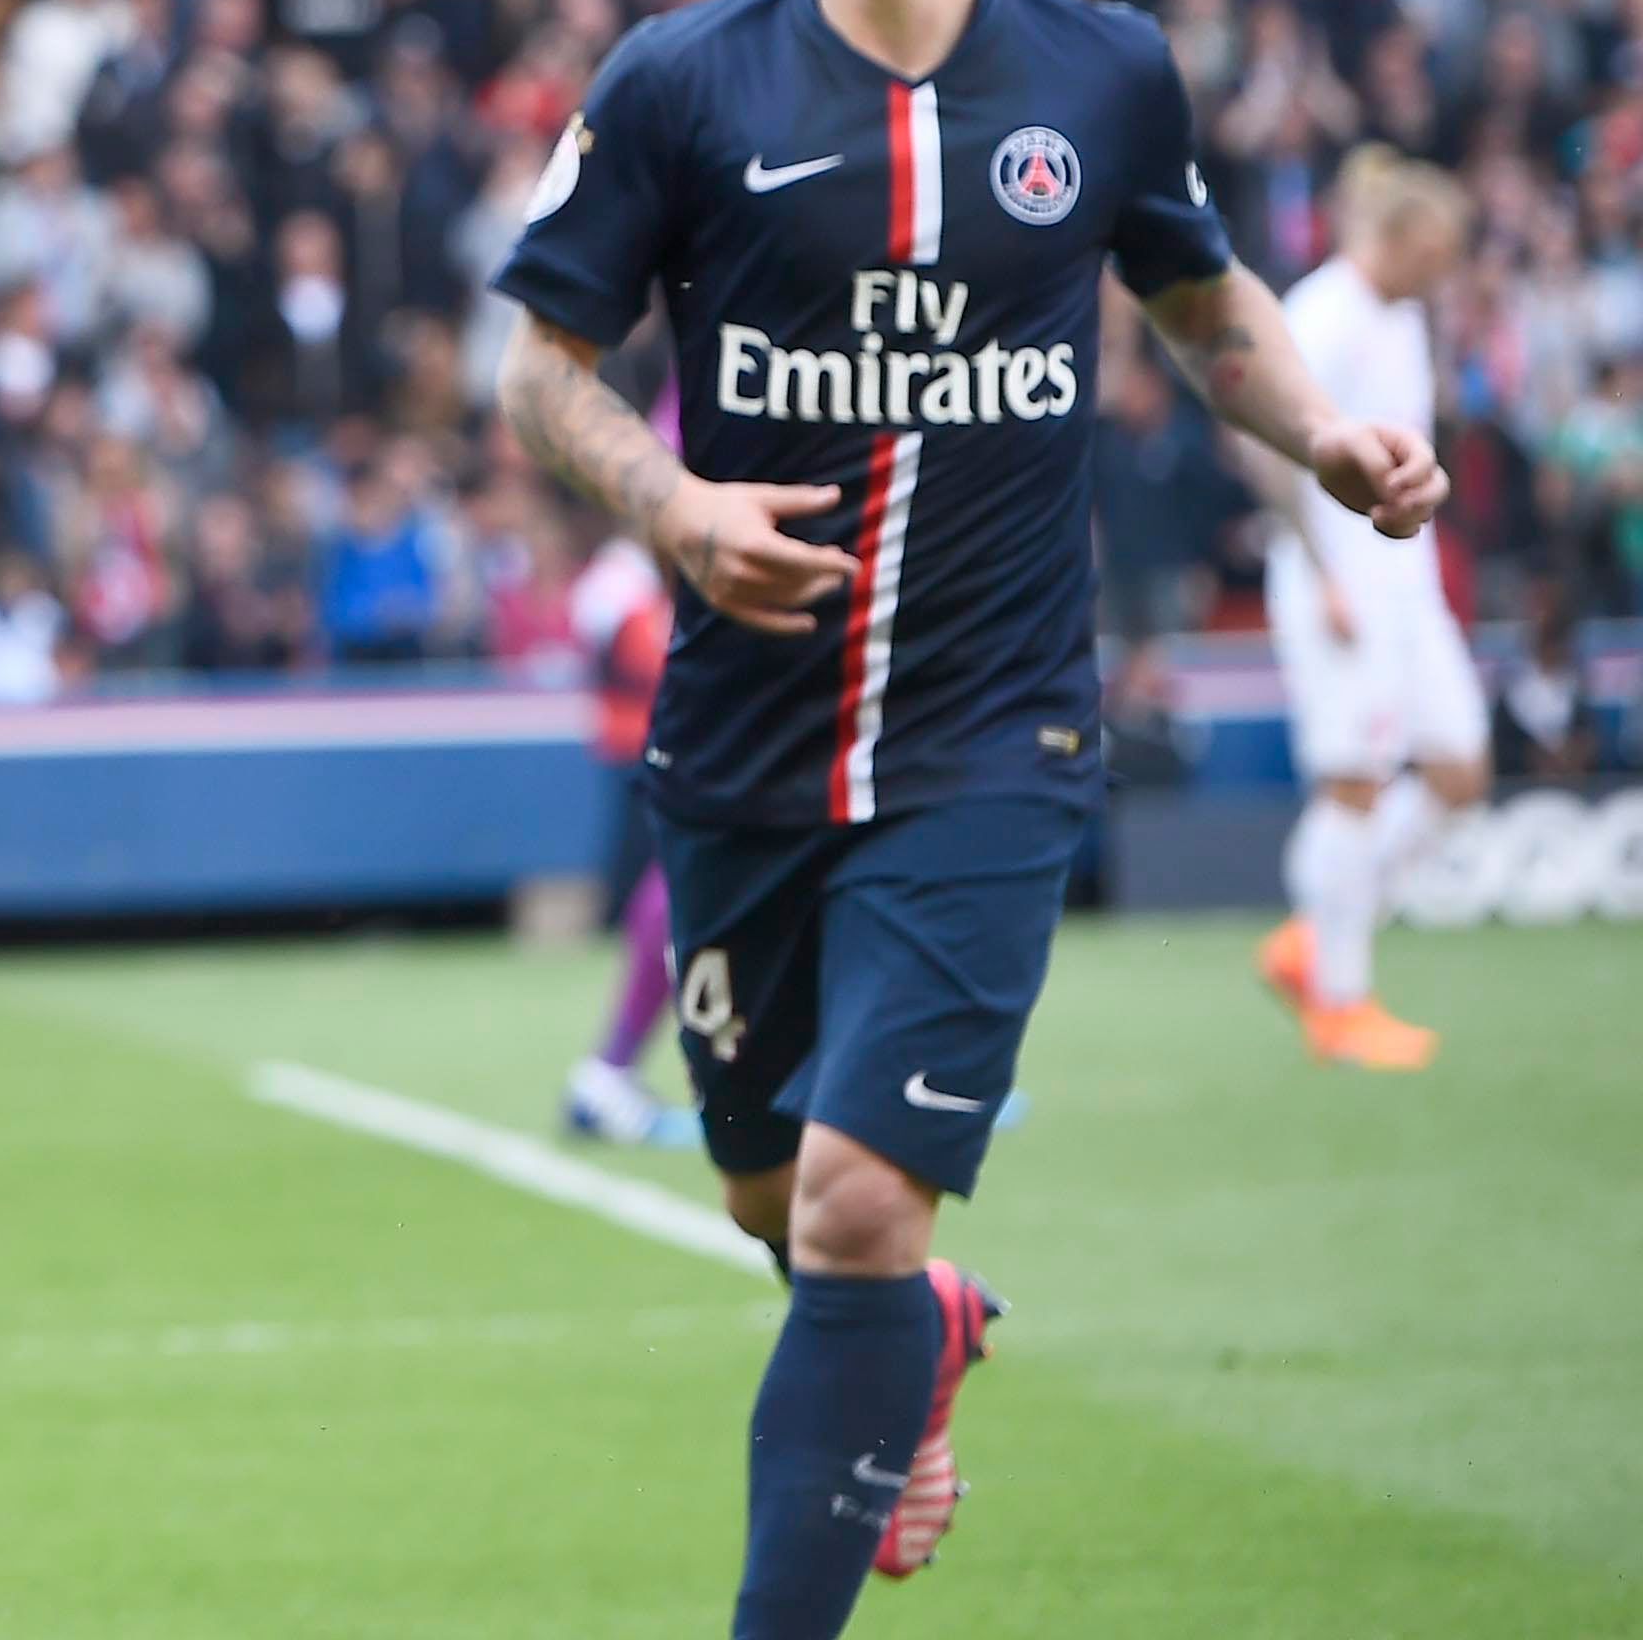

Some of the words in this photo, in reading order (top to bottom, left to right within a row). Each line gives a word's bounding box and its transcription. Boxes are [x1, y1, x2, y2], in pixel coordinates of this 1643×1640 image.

[852, 269, 969, 345] Fly
[718, 322, 1078, 425] Emirates
[663, 946, 746, 1063] 4
